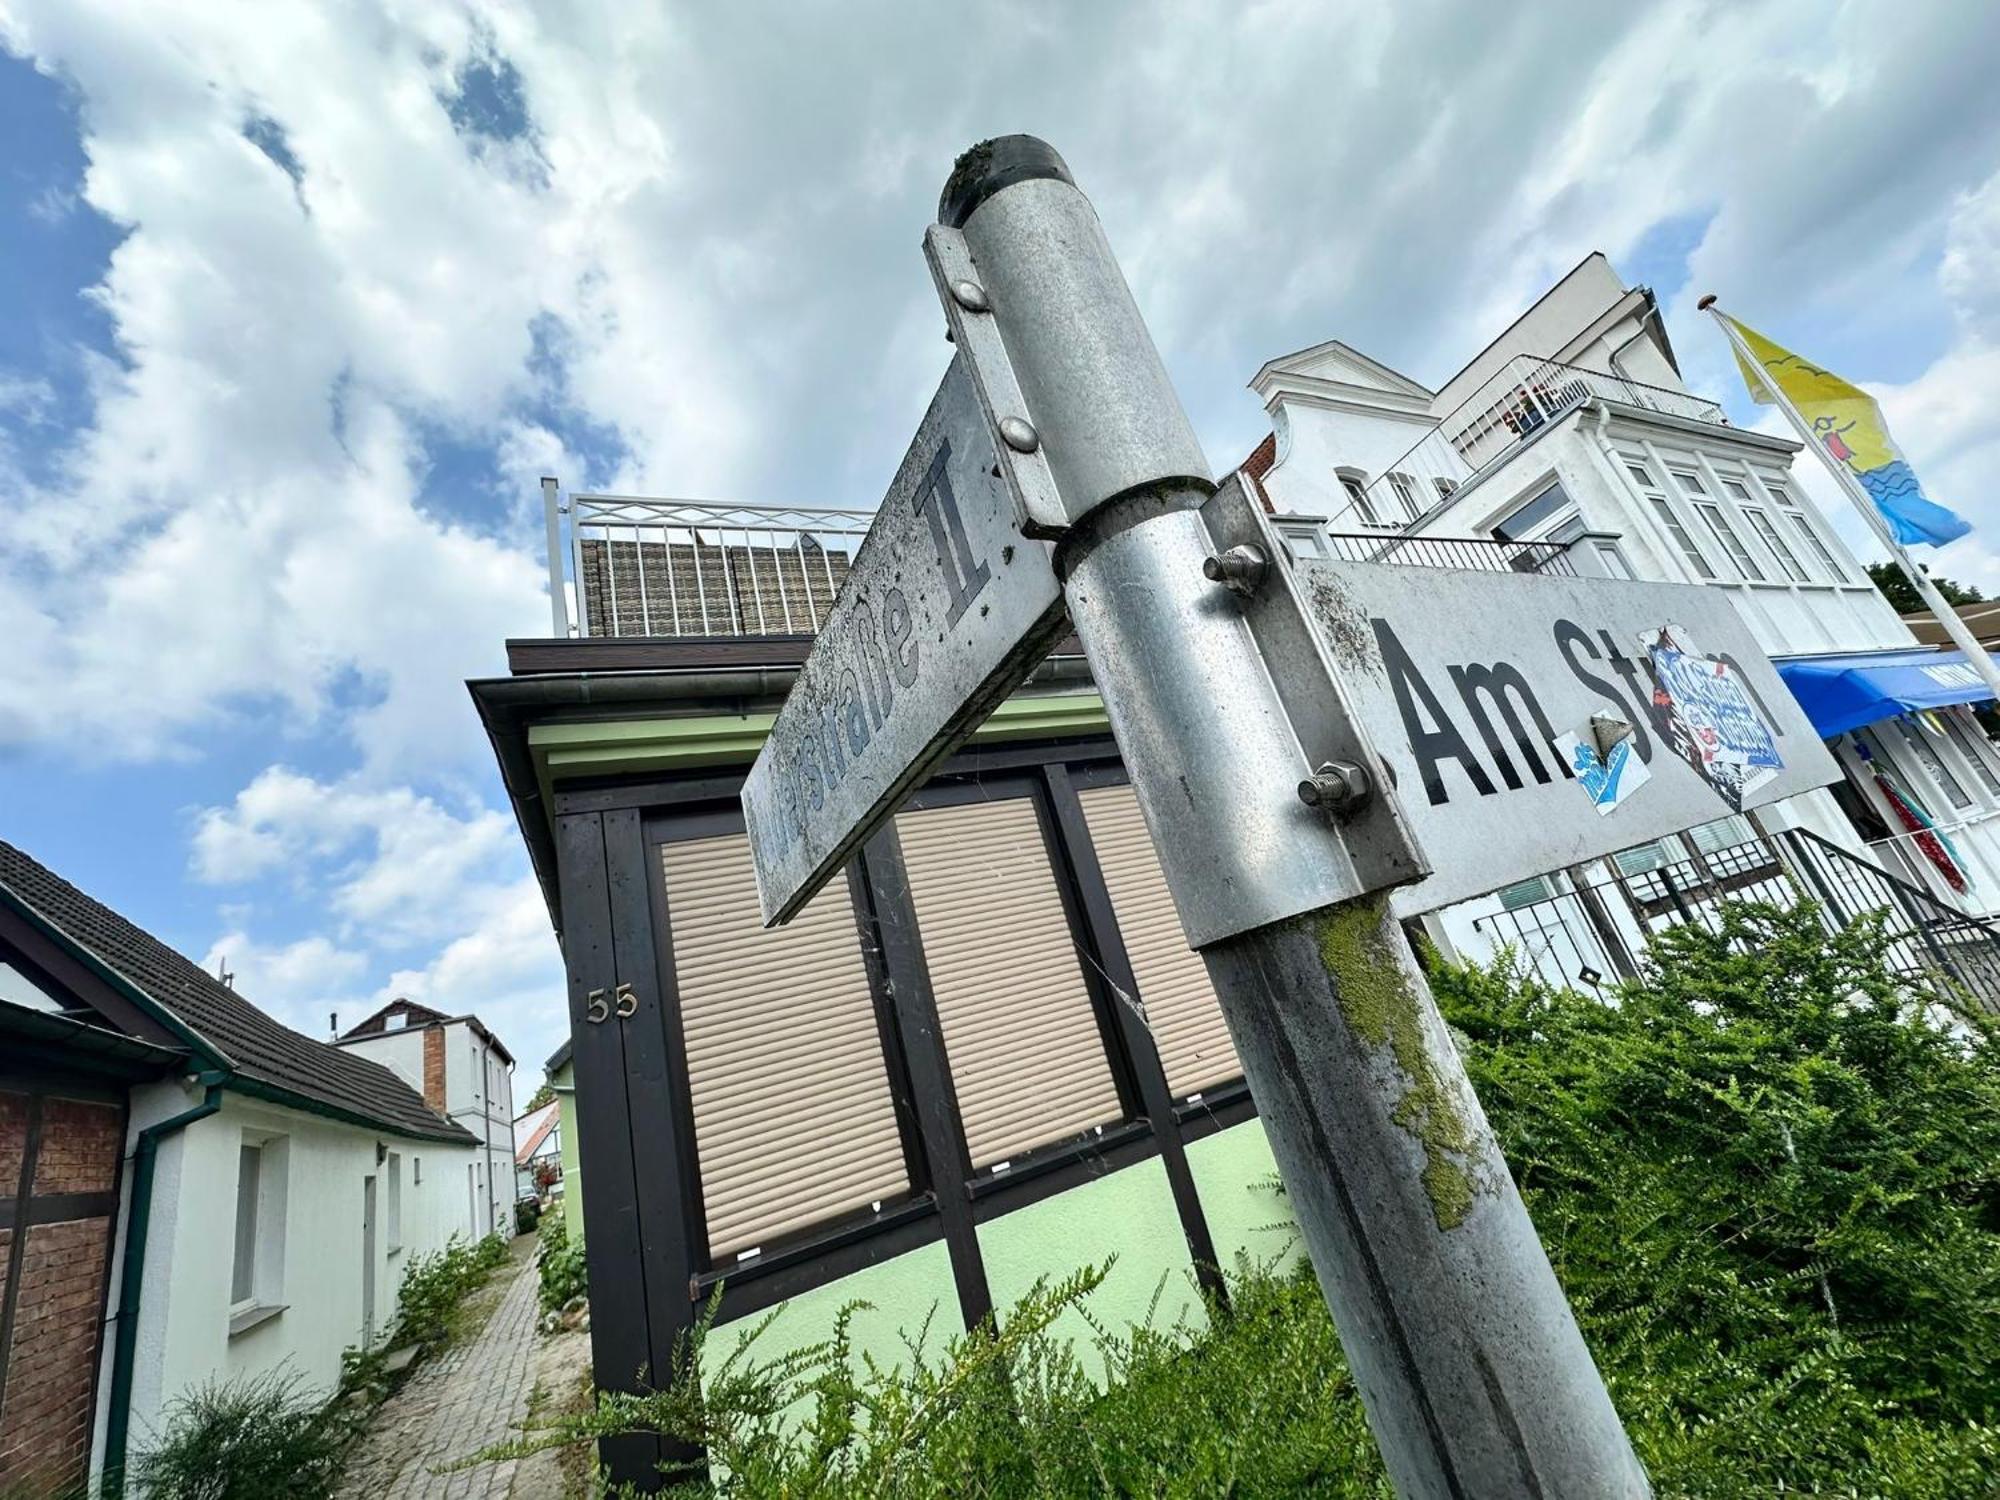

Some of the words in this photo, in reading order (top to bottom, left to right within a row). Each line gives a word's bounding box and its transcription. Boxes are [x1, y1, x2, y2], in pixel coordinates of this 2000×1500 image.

[755, 586, 920, 866] uerstraße
[911, 437, 992, 632] II
[1370, 617, 1576, 806] Am
[1552, 618, 1784, 766] Stm
[586, 982, 638, 1024] 55
